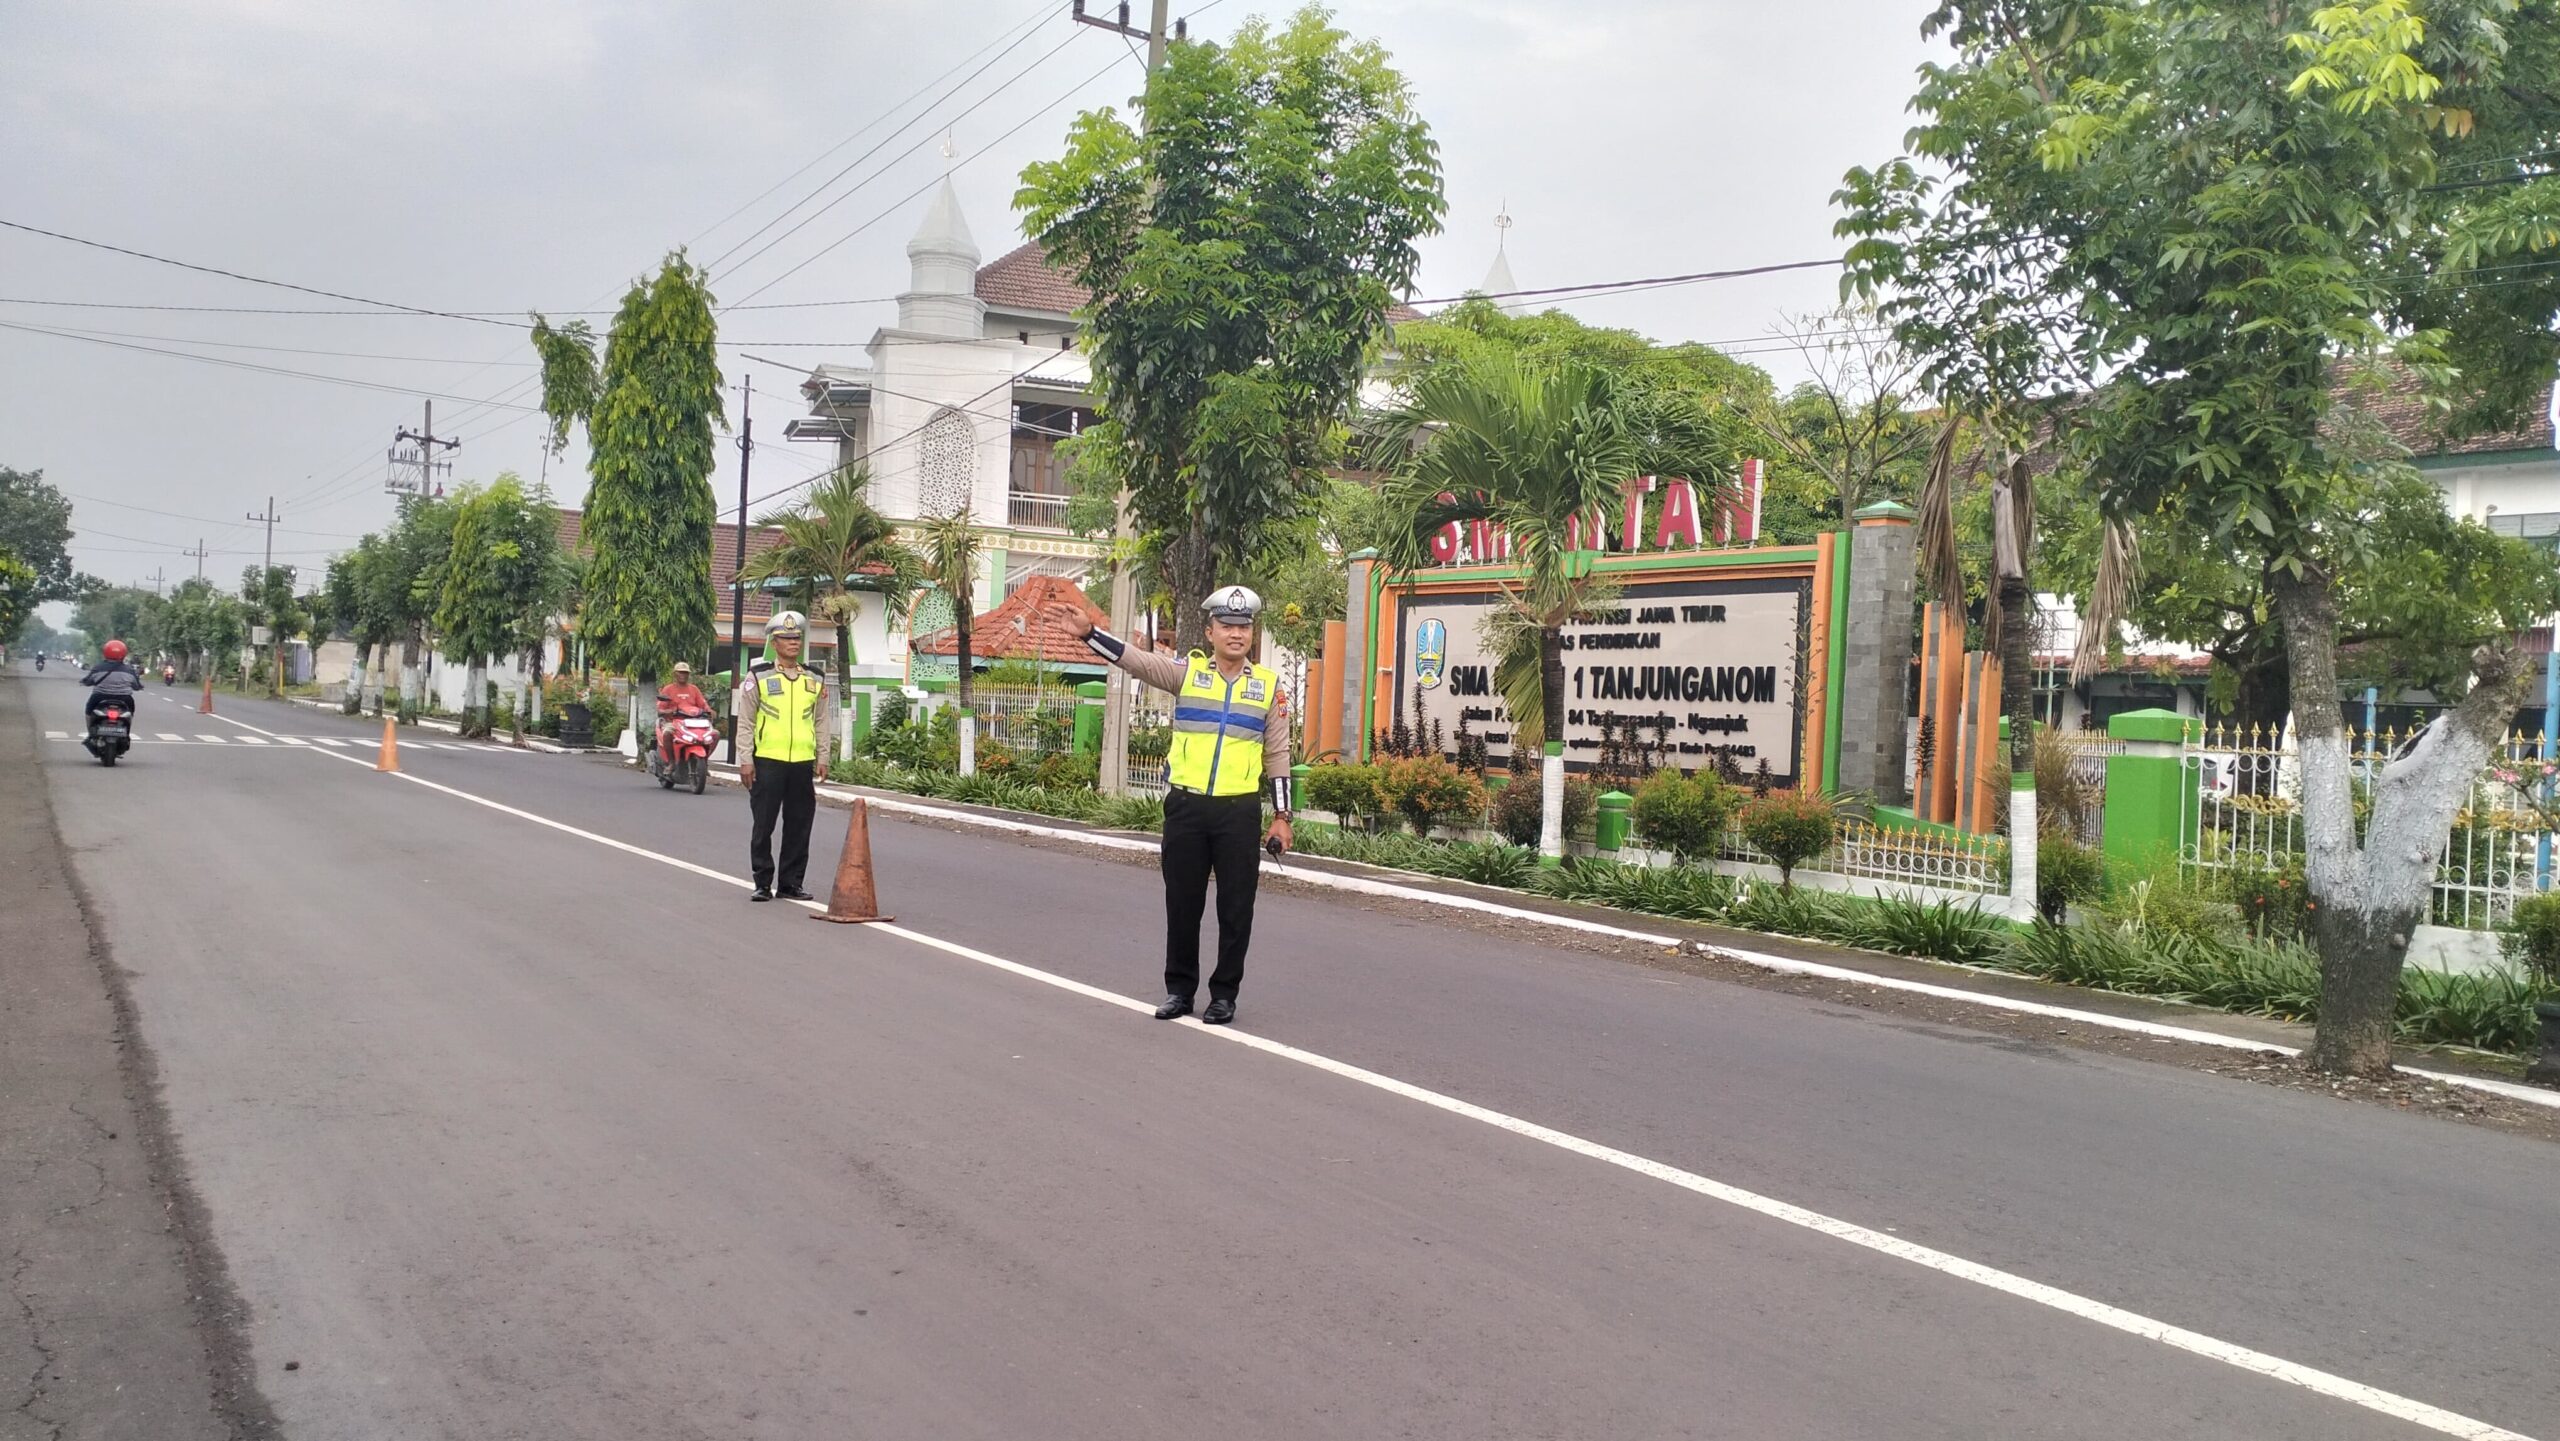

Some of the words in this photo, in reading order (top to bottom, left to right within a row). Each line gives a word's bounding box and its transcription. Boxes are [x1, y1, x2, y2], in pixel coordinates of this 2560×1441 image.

[1636, 606, 1676, 624] JAWA
[1681, 605, 1726, 623] TIMUR
[1579, 632, 1661, 650] PENDIDIKAN
[1449, 665, 1489, 696] SMA
[1574, 666, 1584, 699] 1
[1590, 666, 1776, 702] TANJUNGANOM
[1568, 709, 1584, 725] 84
[1688, 713, 1749, 736] Nganjuk
